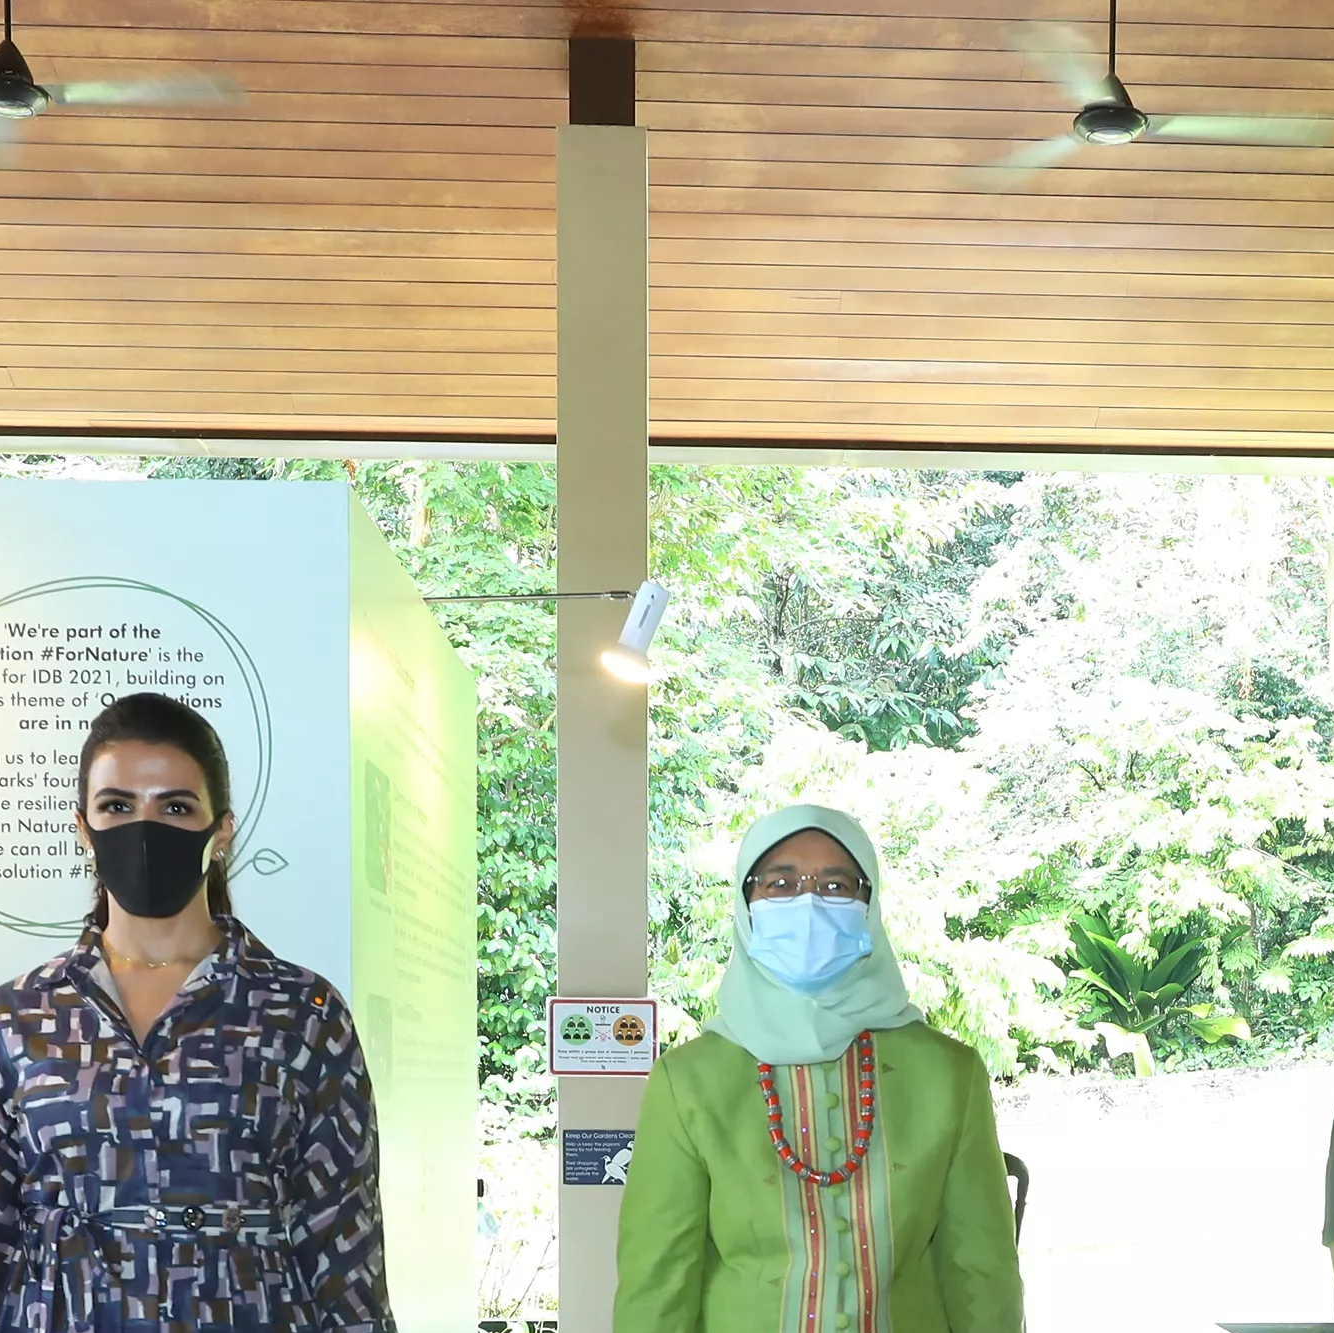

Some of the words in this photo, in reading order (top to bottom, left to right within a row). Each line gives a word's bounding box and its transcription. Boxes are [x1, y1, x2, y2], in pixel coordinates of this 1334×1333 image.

[4, 622, 60, 639] 'We're
[66, 624, 103, 643] part
[108, 622, 128, 639] of
[132, 623, 161, 639] the
[40, 646, 152, 662] #ForNature'
[158, 646, 171, 663] is
[176, 646, 204, 663] the
[1, 667, 27, 684] for
[32, 668, 63, 684] IDB
[68, 669, 120, 688] 2021,
[126, 668, 196, 690] building
[202, 674, 225, 686] on
[10, 691, 66, 708] theme
[71, 691, 89, 708] of
[586, 1006, 621, 1014] NOTICE
